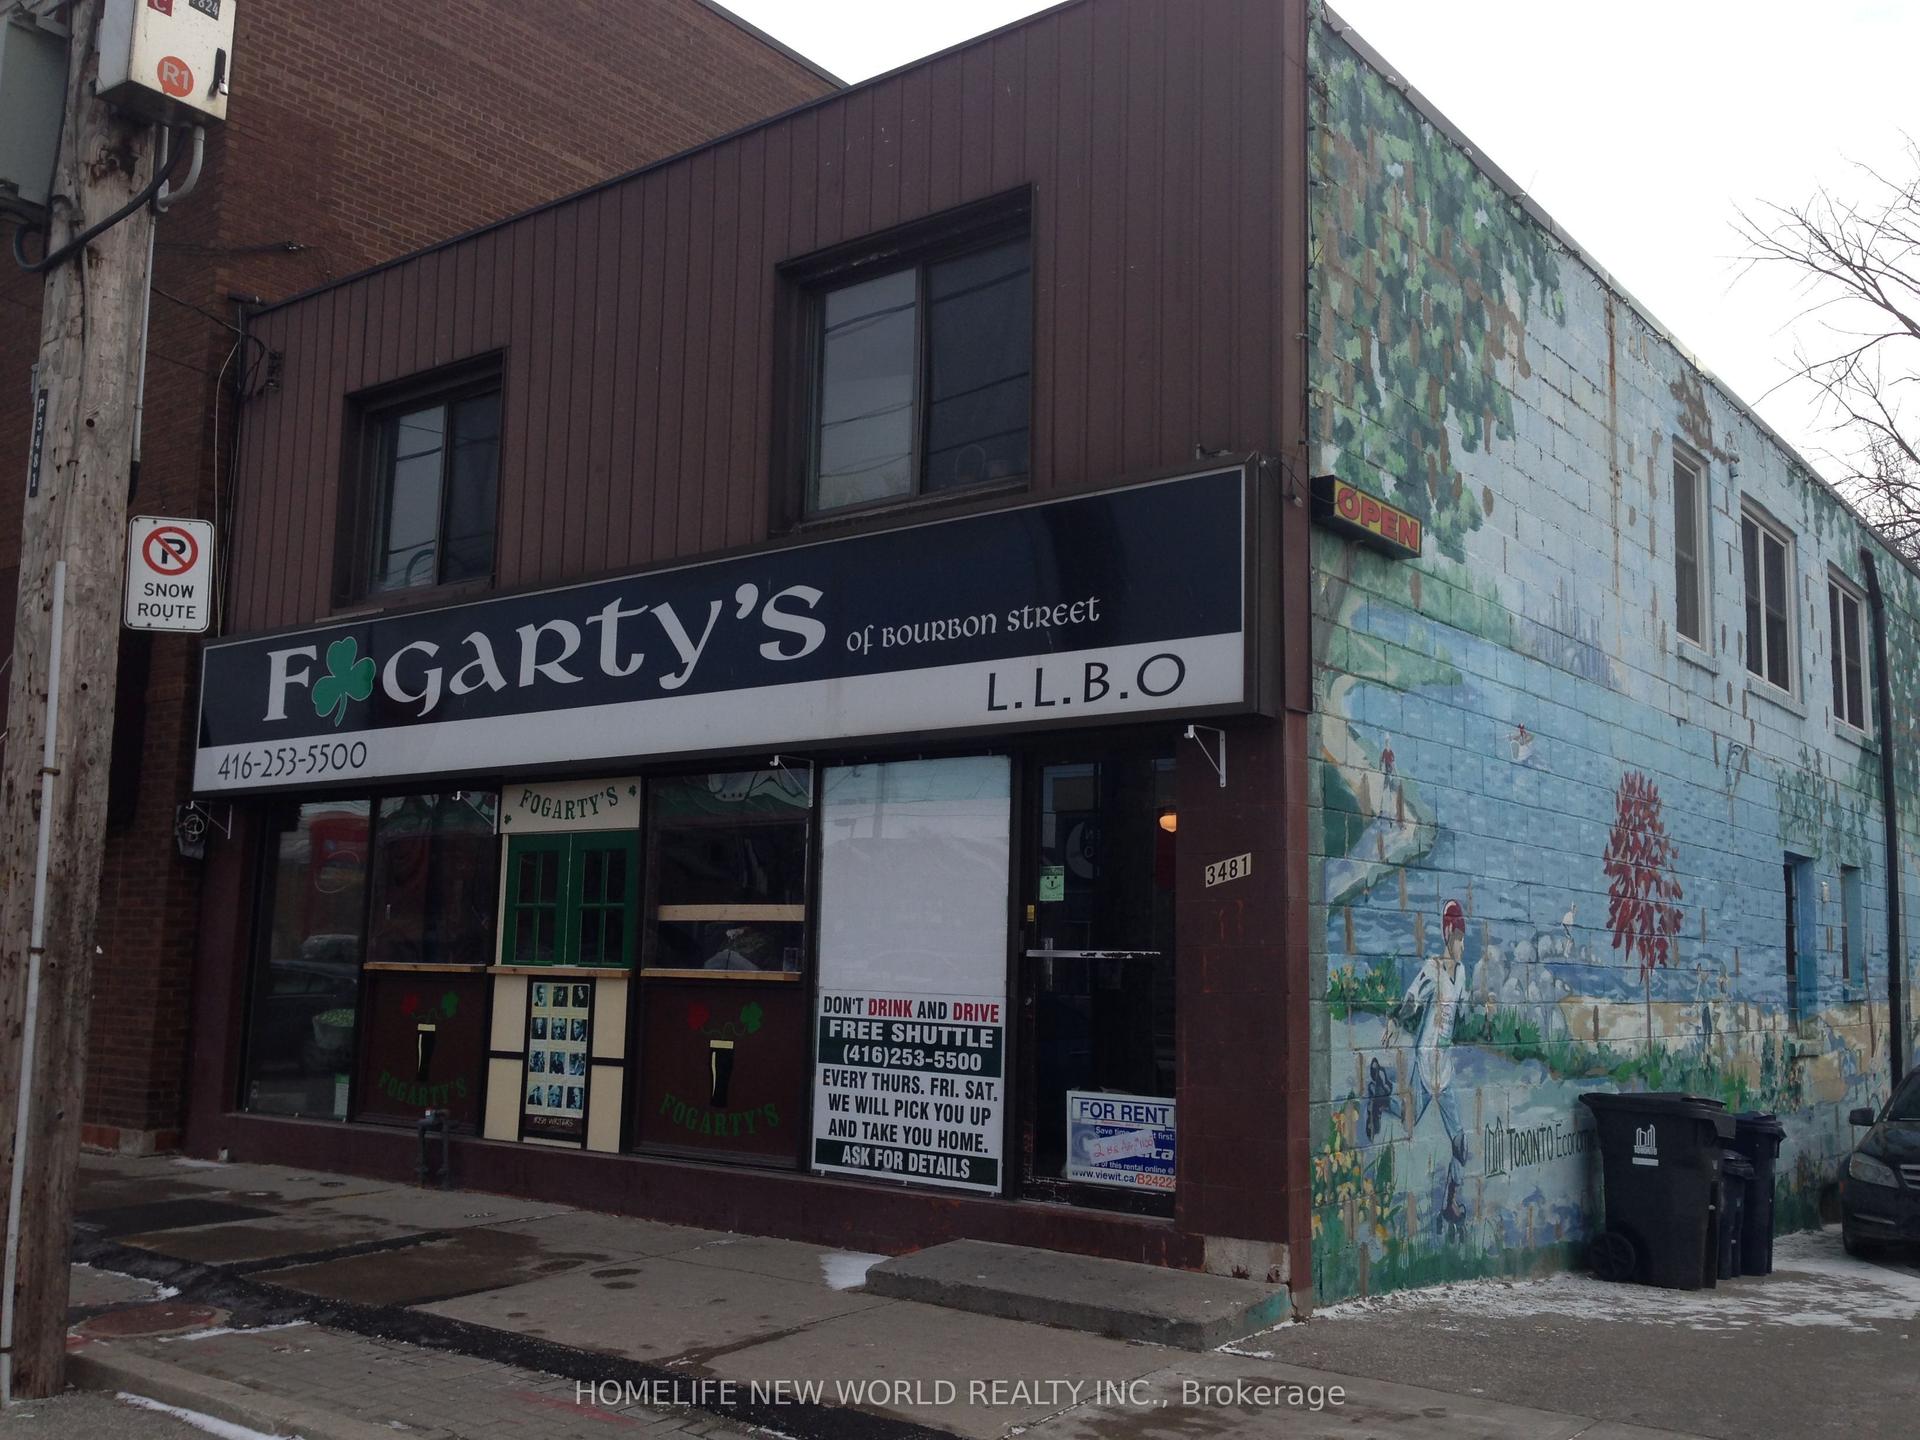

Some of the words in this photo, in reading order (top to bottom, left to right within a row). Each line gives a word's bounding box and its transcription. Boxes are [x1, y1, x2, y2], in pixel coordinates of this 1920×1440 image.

[162, 61, 189, 90] R1
[1338, 487, 1419, 550] OPEN
[144, 582, 195, 599] SNOW
[138, 602, 197, 620] ROUTE
[262, 583, 826, 722] FGARTY'S
[987, 653, 1186, 711] L.L.B.O
[218, 741, 368, 780] 416-253-5500
[519, 785, 619, 820] FOGARTY'S
[1207, 856, 1250, 886] 3481
[824, 996, 864, 1015] DON'T
[868, 999, 913, 1018] DRINK
[917, 1001, 948, 1020] AND
[953, 1002, 1000, 1023] DRIVE
[829, 1020, 883, 1041] FREE
[891, 1024, 994, 1048] SHUTTLE
[843, 1044, 982, 1071] (416)253-5500
[823, 1069, 868, 1089] EVERY
[872, 1073, 925, 1095] THURS.
[930, 1078, 959, 1098] FRI.
[965, 1081, 998, 1102] SAT.
[658, 1092, 780, 1137] FOGARTY'S
[828, 1093, 850, 1113] WE
[855, 1096, 889, 1117] WILL
[894, 1099, 930, 1121] PICK
[934, 1103, 964, 1124] YOU
[970, 1106, 991, 1126] UP
[1080, 1101, 1115, 1120] FOR
[1121, 1104, 1169, 1124] RENT
[828, 1118, 857, 1138] AND
[862, 1122, 898, 1143] TAKE
[903, 1126, 932, 1147] YOU
[938, 1130, 989, 1153] HOME.
[1096, 1126, 1113, 1136] Save
[842, 1145, 870, 1167] ASK
[874, 1149, 903, 1171] FOR
[908, 1153, 971, 1179] DETAILS
[1507, 1126, 1554, 1171] TORONTO
[1109, 1161, 1122, 1169] this
[1123, 1162, 1144, 1172] rental
[1145, 1165, 1166, 1175] online
